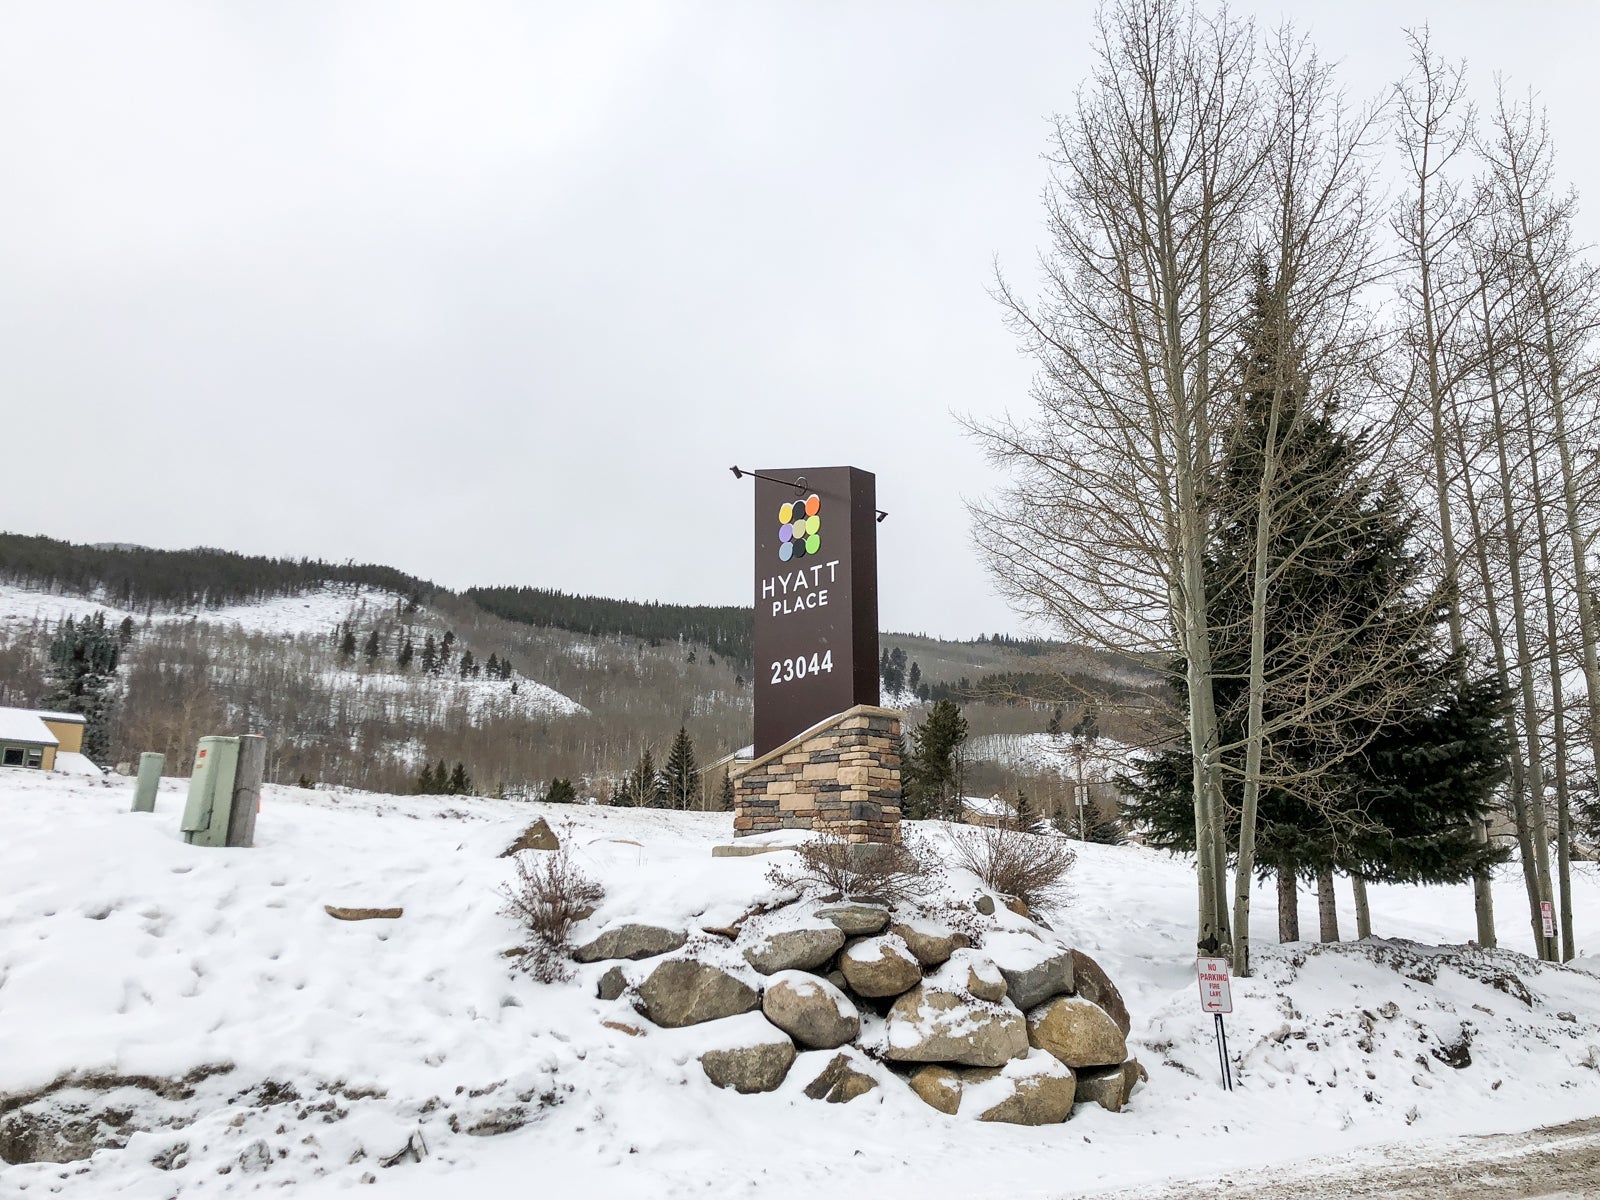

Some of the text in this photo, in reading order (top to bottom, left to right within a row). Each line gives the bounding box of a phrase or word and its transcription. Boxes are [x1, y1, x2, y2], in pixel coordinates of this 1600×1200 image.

[762, 560, 840, 599] HYATT
[772, 589, 829, 617] PLACE
[770, 649, 834, 685] 23044
[1200, 973, 1228, 981] PARKING
[1207, 963, 1217, 971] NO
